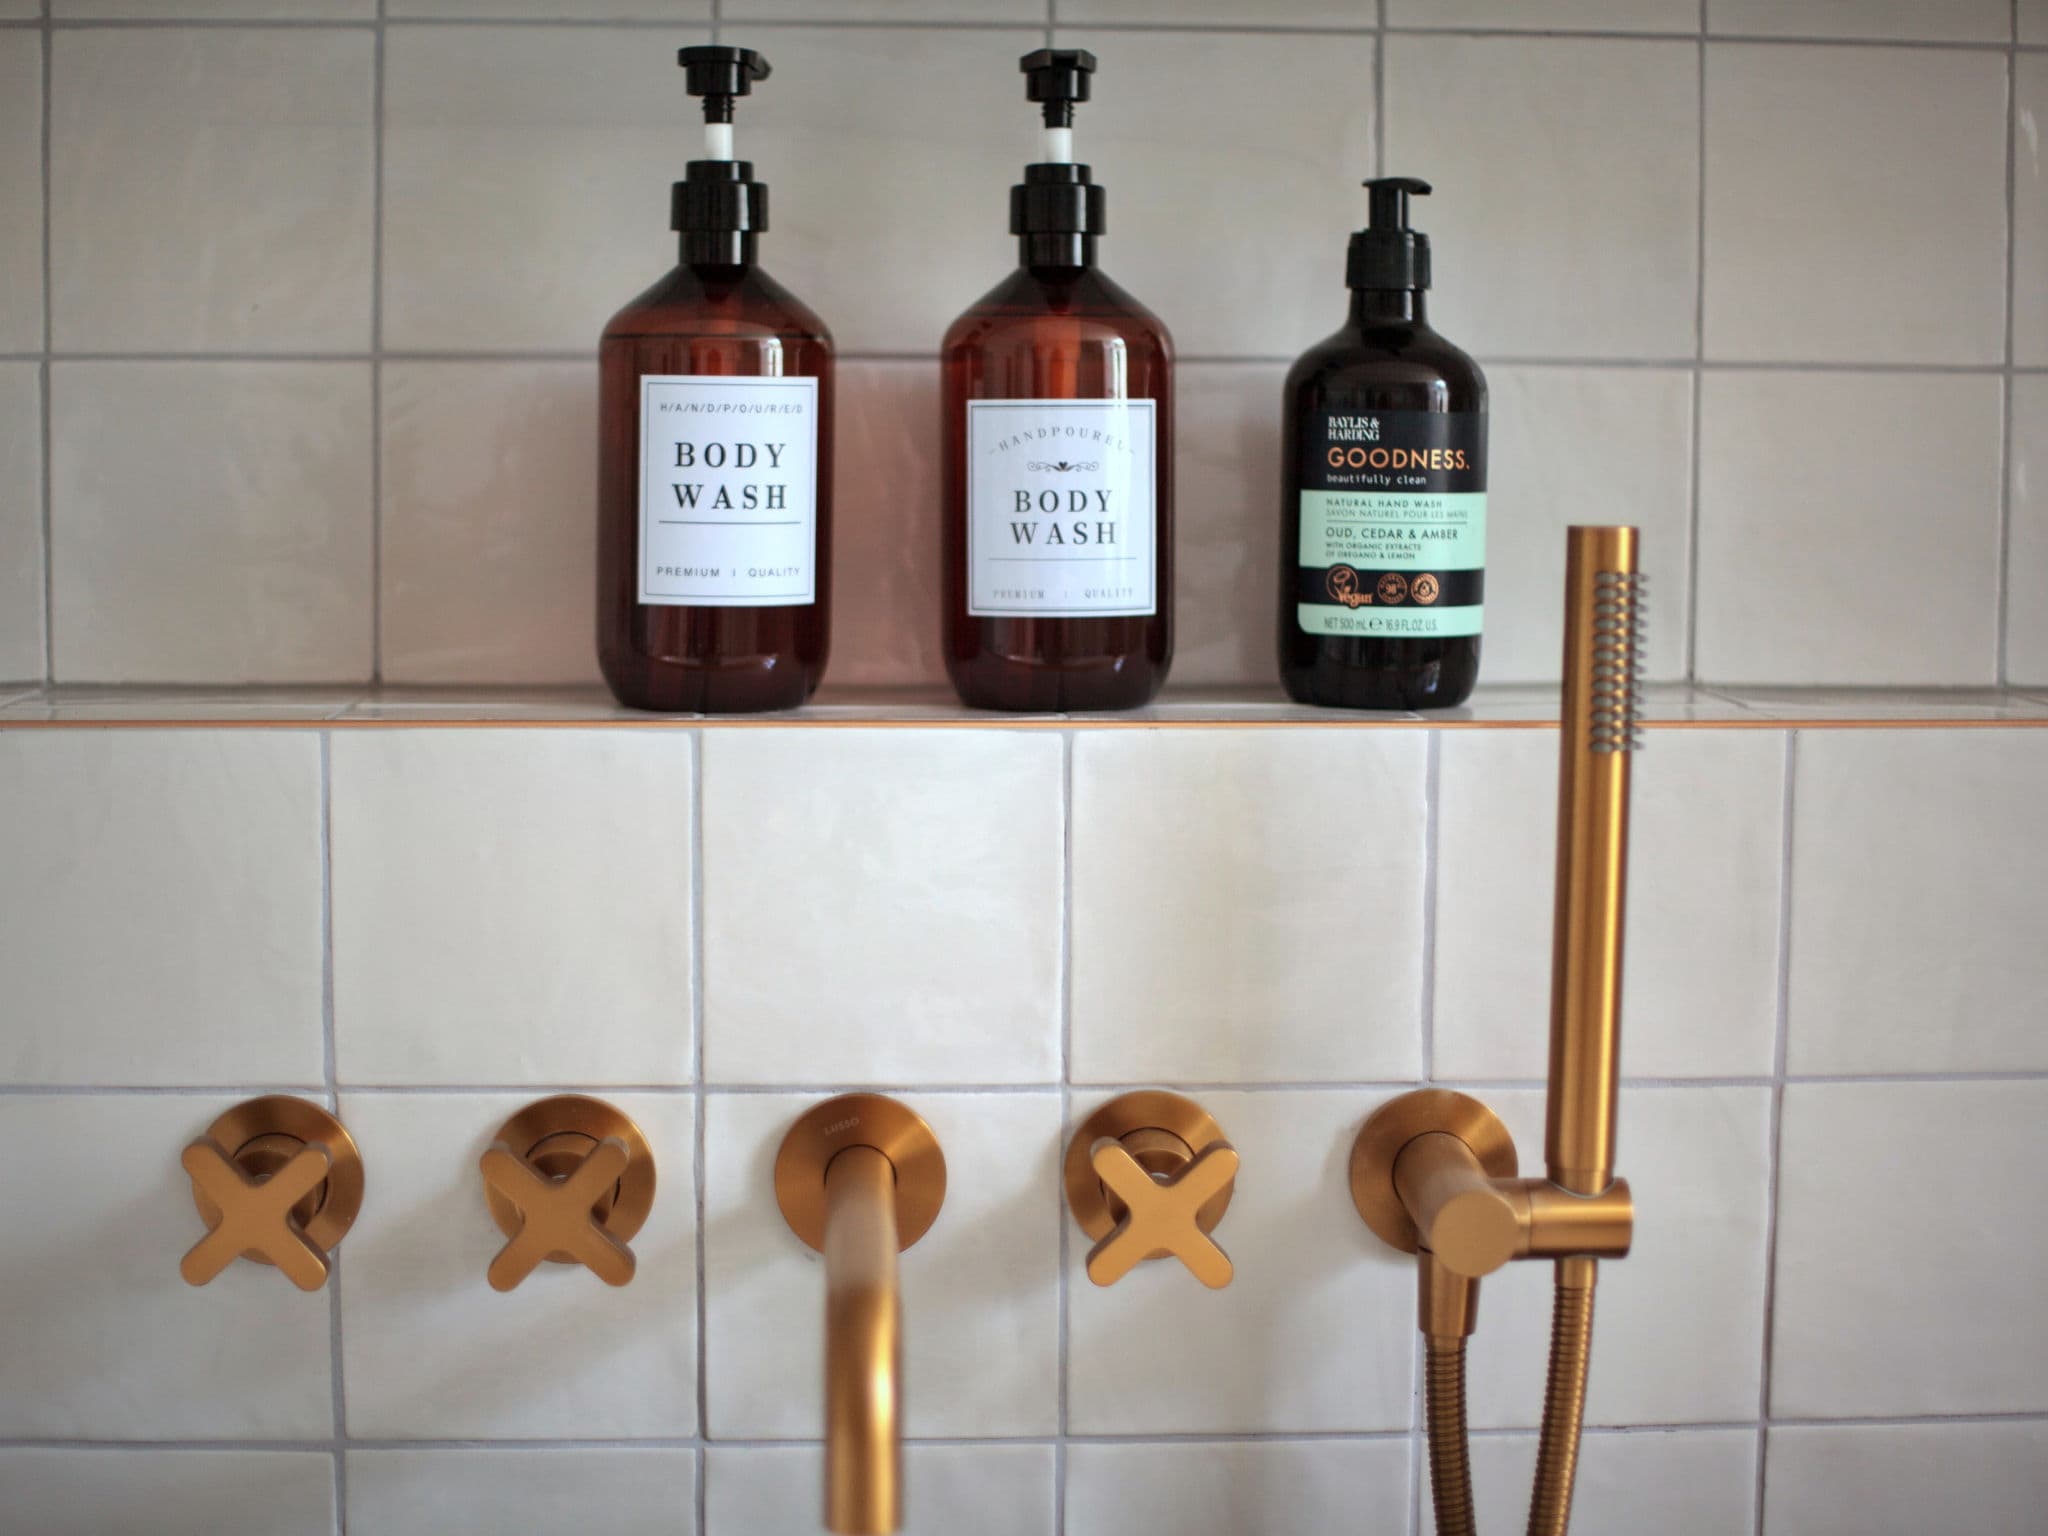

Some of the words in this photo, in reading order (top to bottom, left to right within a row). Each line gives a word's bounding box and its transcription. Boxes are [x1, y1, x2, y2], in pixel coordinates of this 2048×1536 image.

[1328, 416, 1369, 428] BAYLIS
[1370, 416, 1380, 428] &
[1327, 428, 1380, 441] HARDING
[674, 442, 786, 468] BODY
[1327, 447, 1470, 470] GOODNESS.
[1327, 474, 1391, 486] beautifully
[1397, 474, 1427, 485] clean
[672, 484, 787, 510] WASH
[1013, 489, 1113, 513] BODY
[1326, 498, 1372, 508] NATURAL
[1378, 498, 1409, 508] HAND
[1414, 499, 1442, 508] WASH
[1326, 509, 1356, 517] SAVON
[1359, 509, 1399, 518] NATUREL
[1403, 510, 1427, 519] POUR
[1010, 521, 1117, 545] WASH
[1326, 527, 1356, 539] OUD,
[1361, 527, 1403, 539] CEDAR
[1408, 528, 1417, 539] &
[1421, 529, 1458, 540] AMBER
[1346, 542, 1383, 550] ORGANIC
[1385, 543, 1421, 551] EXTRACTS
[1337, 551, 1377, 559] OREGANO
[1388, 552, 1415, 560] LEMON
[657, 566, 720, 577] PREMIUM
[748, 567, 801, 578] QUALITY
[993, 589, 1045, 599] PREMIUM
[1084, 588, 1134, 599] QUALITY
[1324, 617, 1339, 629] NET
[1339, 617, 1354, 629] 500
